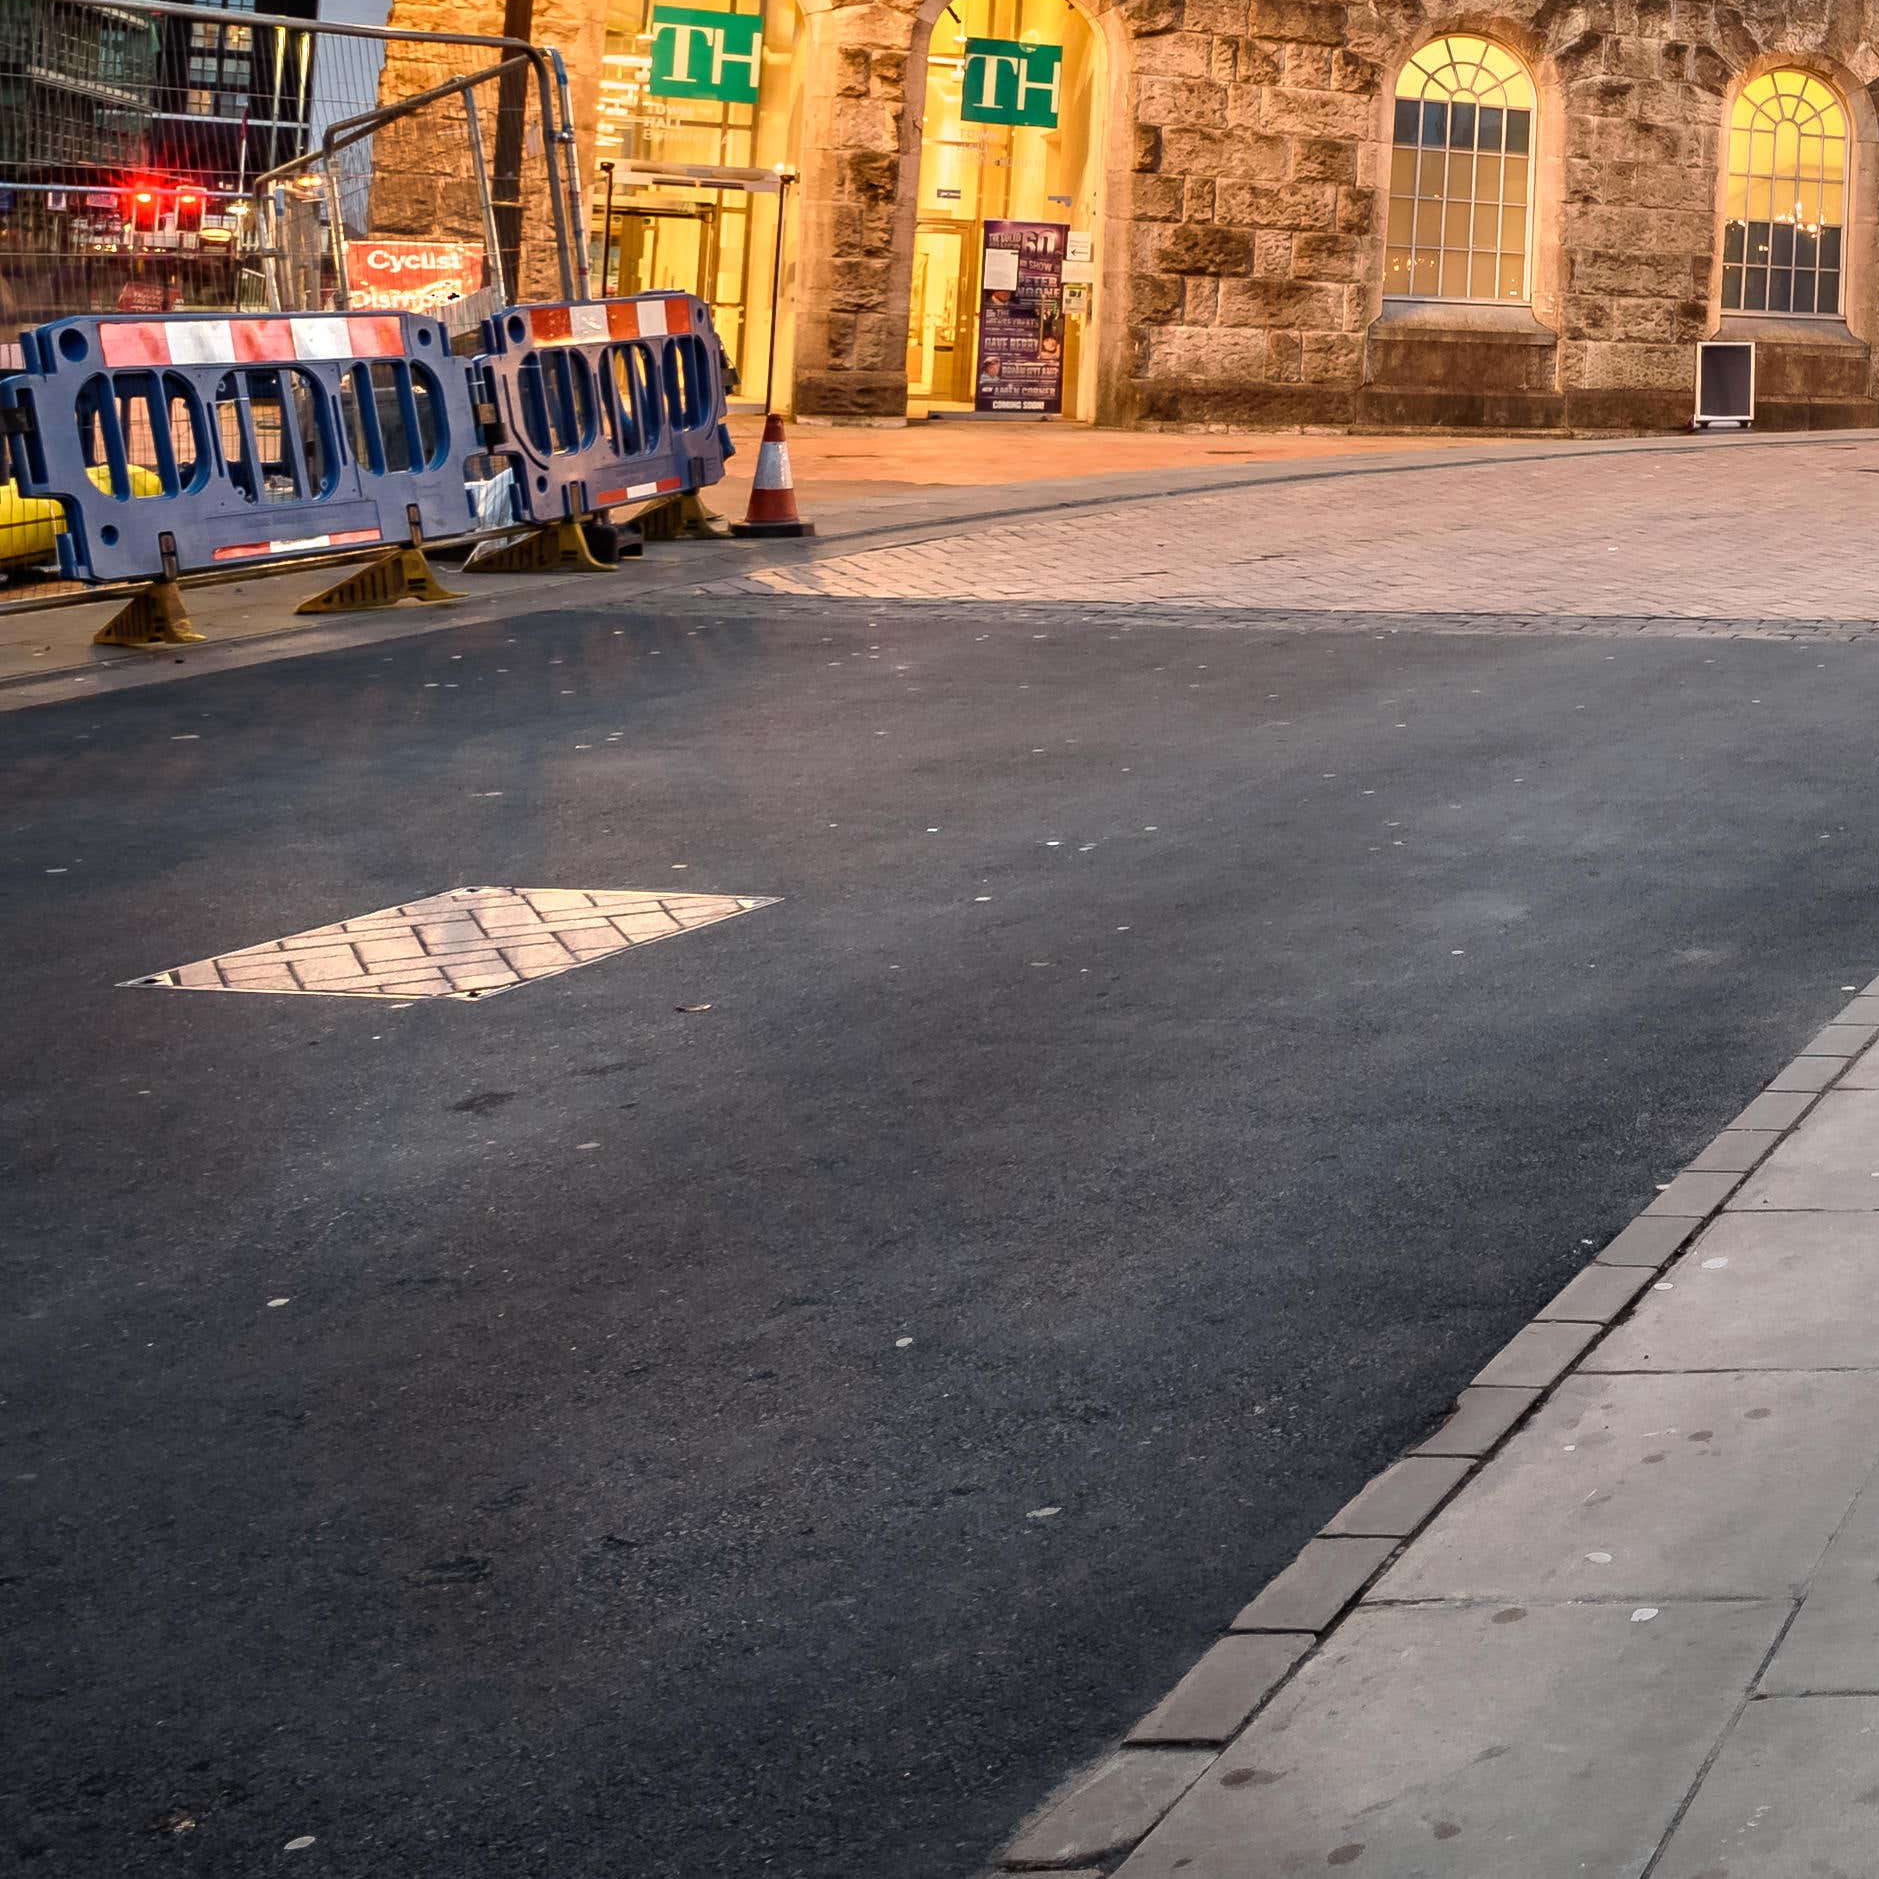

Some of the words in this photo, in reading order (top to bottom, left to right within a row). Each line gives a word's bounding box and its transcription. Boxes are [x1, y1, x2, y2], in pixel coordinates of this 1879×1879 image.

[652, 21, 763, 88] TH
[965, 52, 1062, 114] TH
[367, 249, 463, 274] Cyclist
[1029, 261, 1053, 272] SHOW
